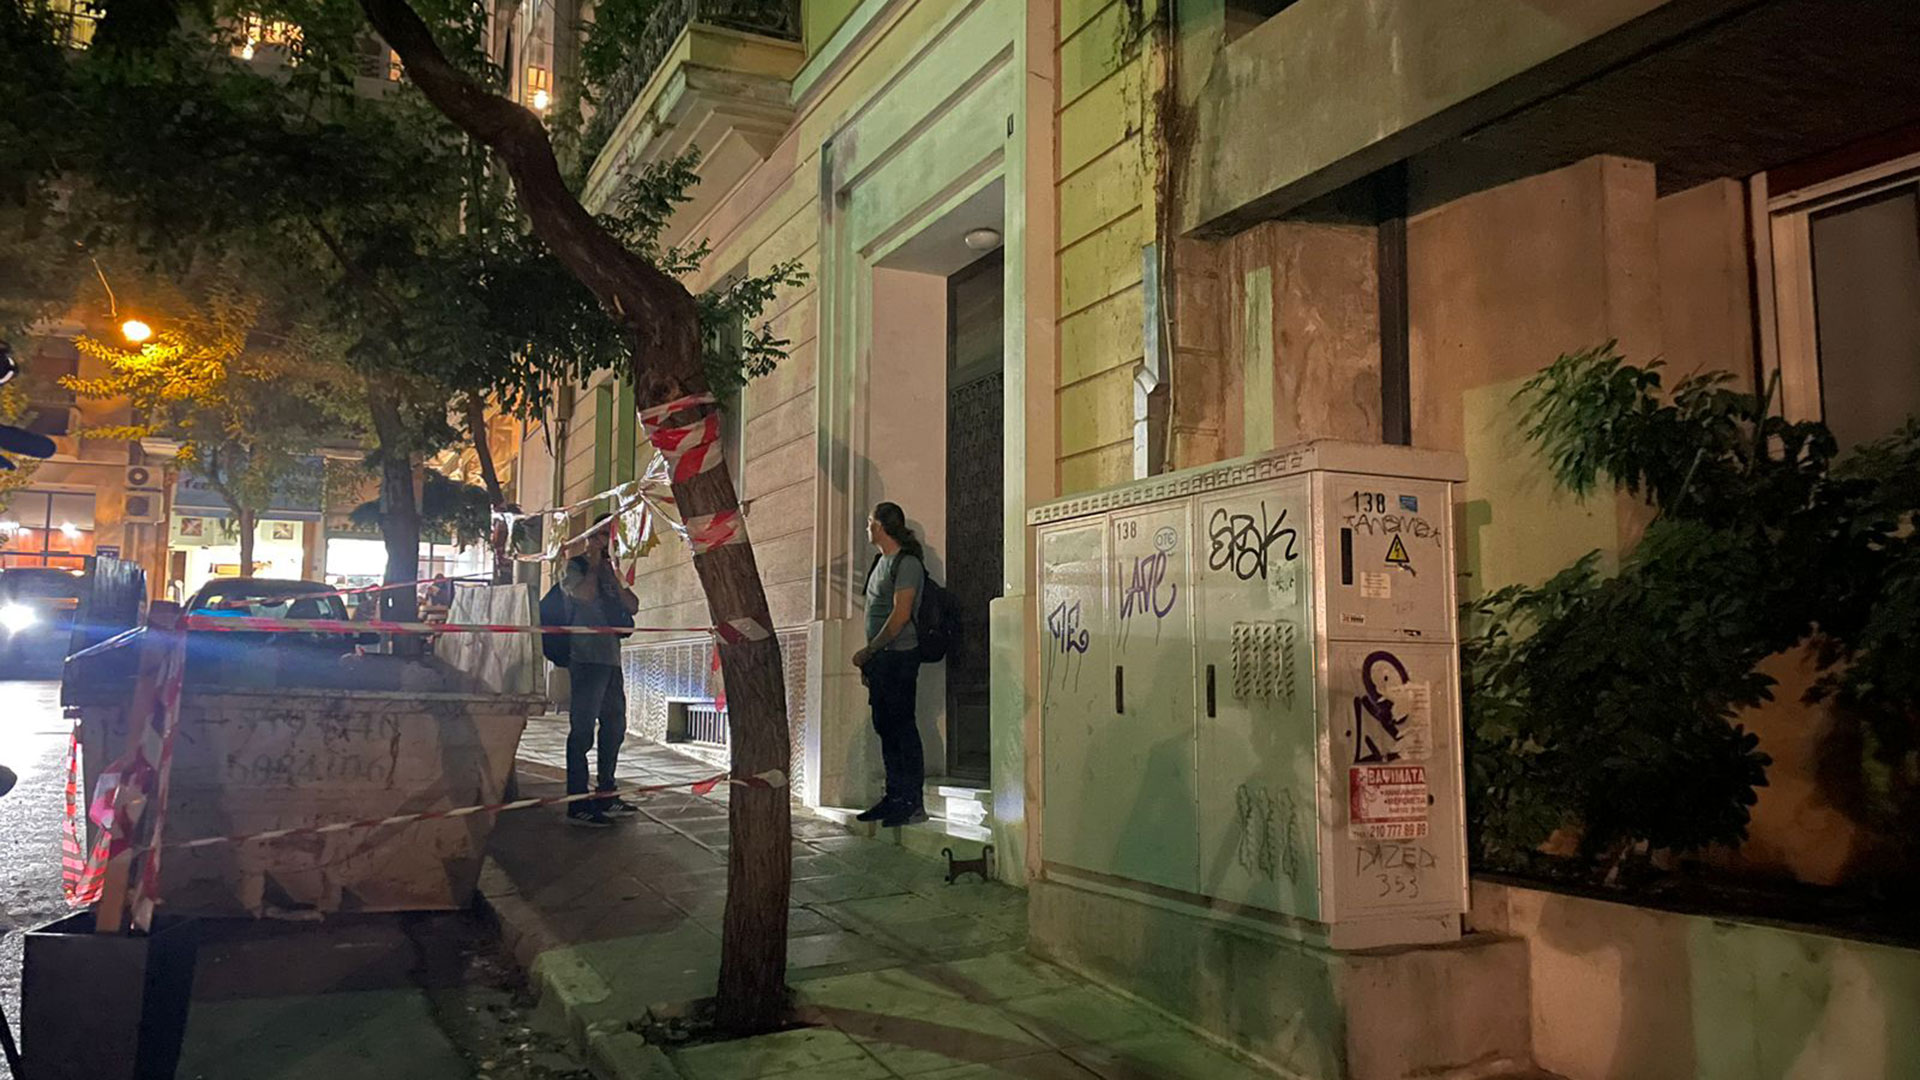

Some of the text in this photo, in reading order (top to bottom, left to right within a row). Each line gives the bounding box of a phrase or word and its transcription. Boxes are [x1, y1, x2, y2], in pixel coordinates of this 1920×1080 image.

[1353, 491, 1386, 514] 138
[1117, 521, 1137, 540] 138
[1370, 825, 1386, 838] 210
[1387, 824, 1402, 837] 777
[1375, 873, 1418, 899] 353
